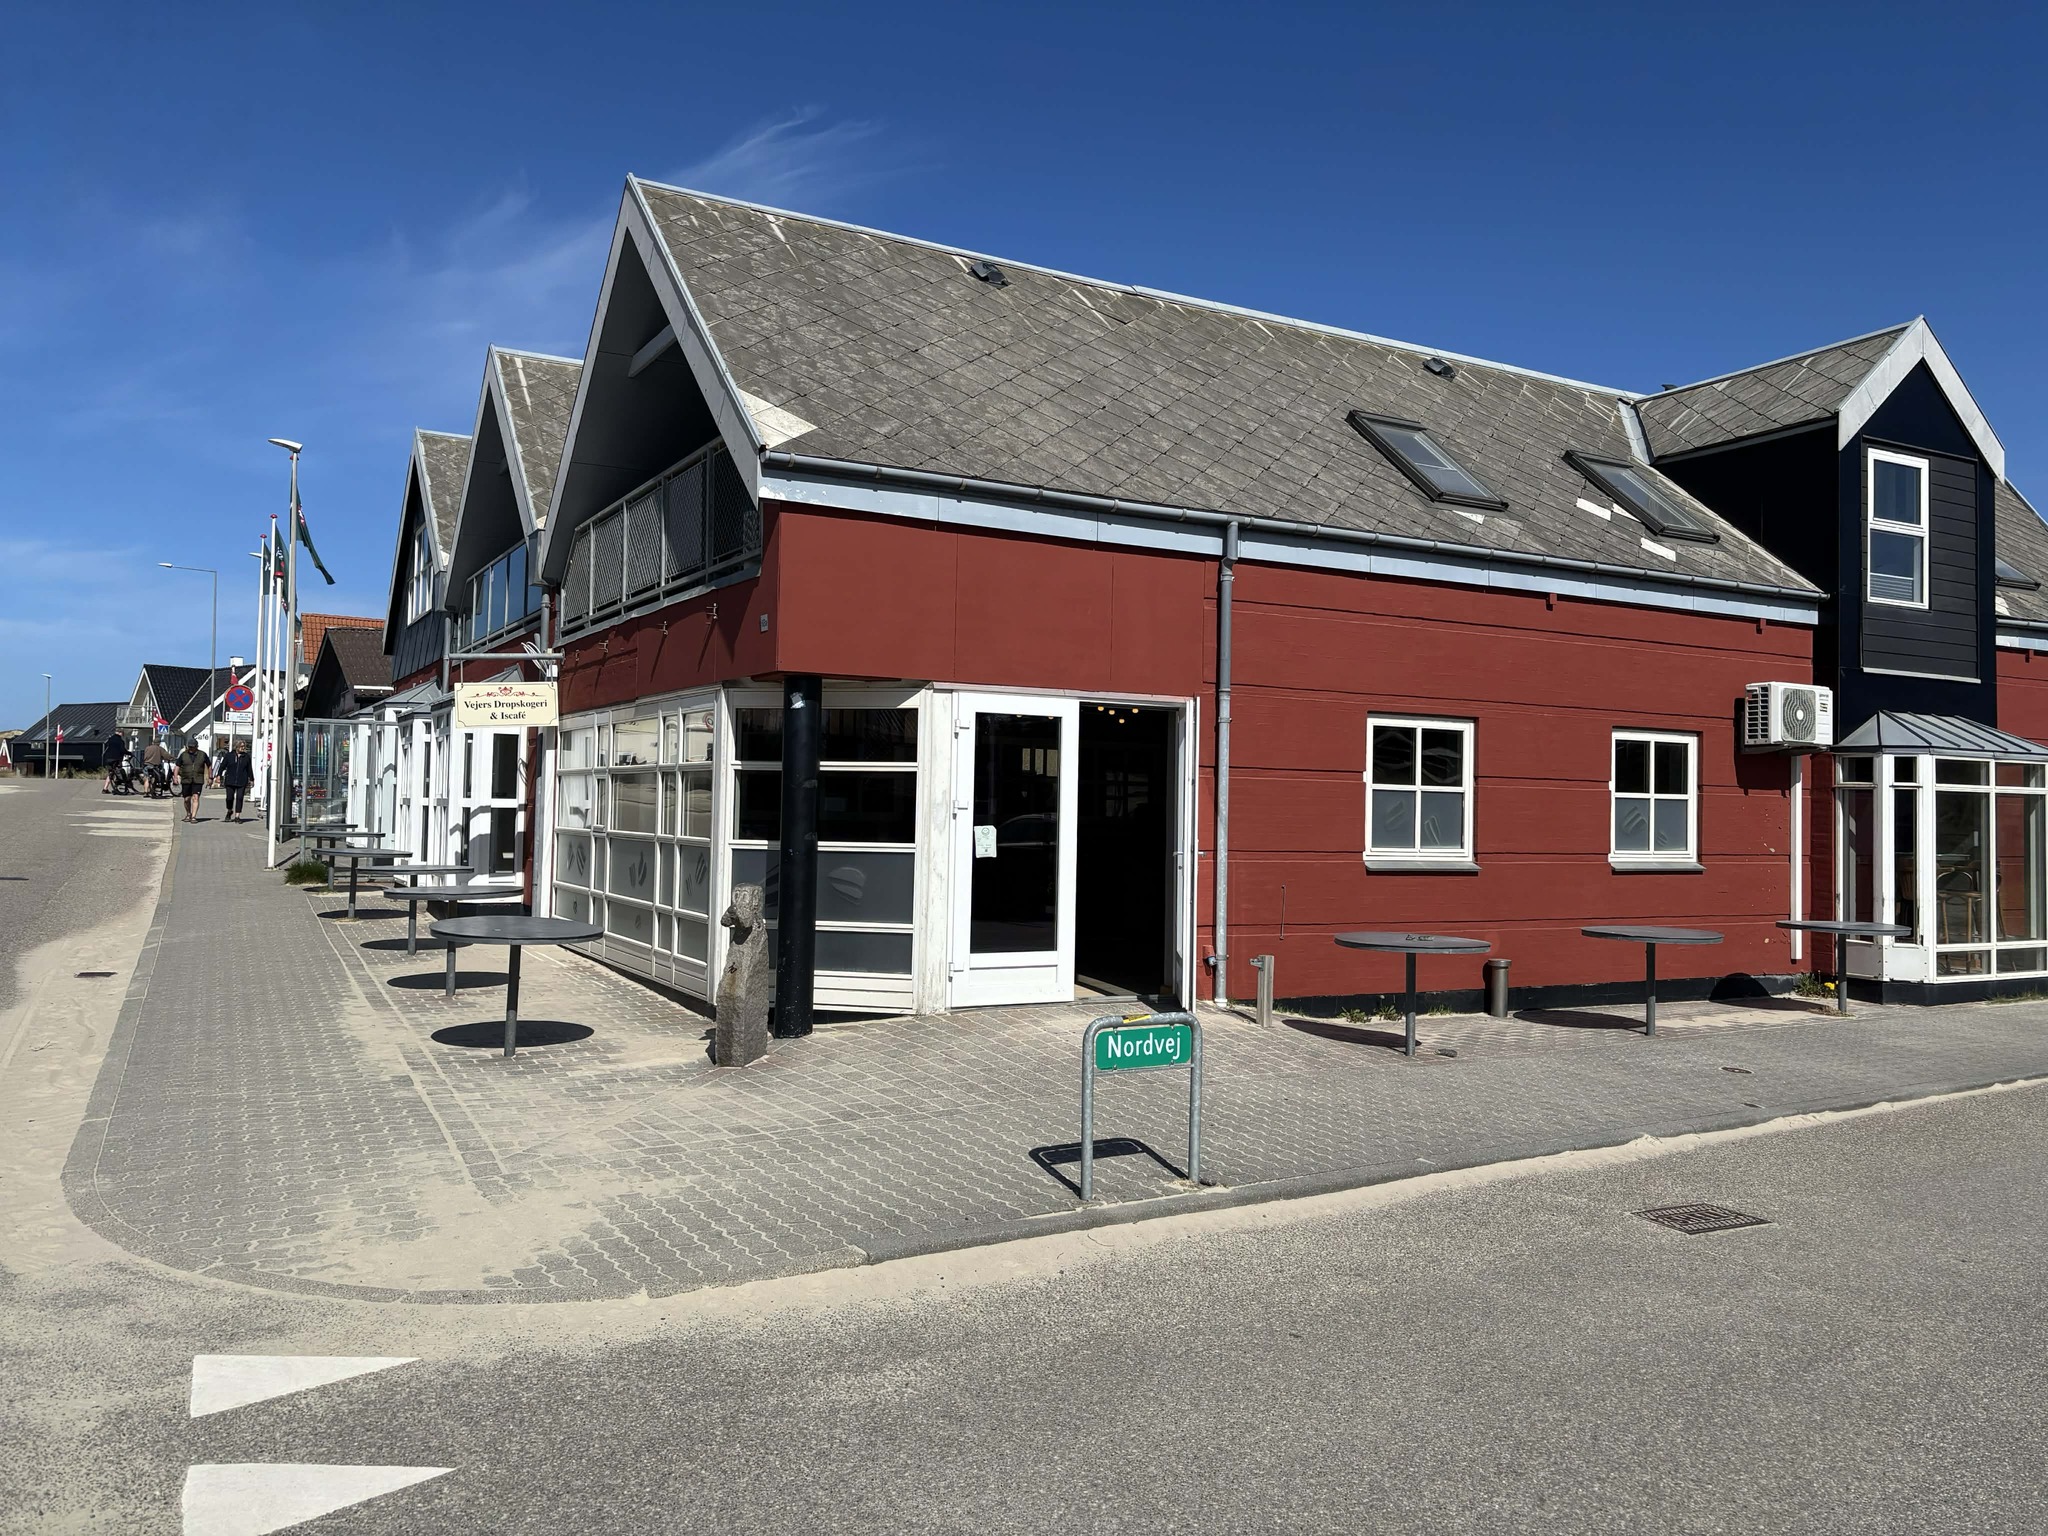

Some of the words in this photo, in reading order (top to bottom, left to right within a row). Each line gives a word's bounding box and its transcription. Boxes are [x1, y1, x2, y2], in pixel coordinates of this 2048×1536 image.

[464, 701, 492, 710] Vejers
[494, 699, 548, 709] Dropskogeri
[489, 712, 498, 720] &
[501, 711, 526, 720] Iscafé
[1108, 1032, 1181, 1060] Nordvej
